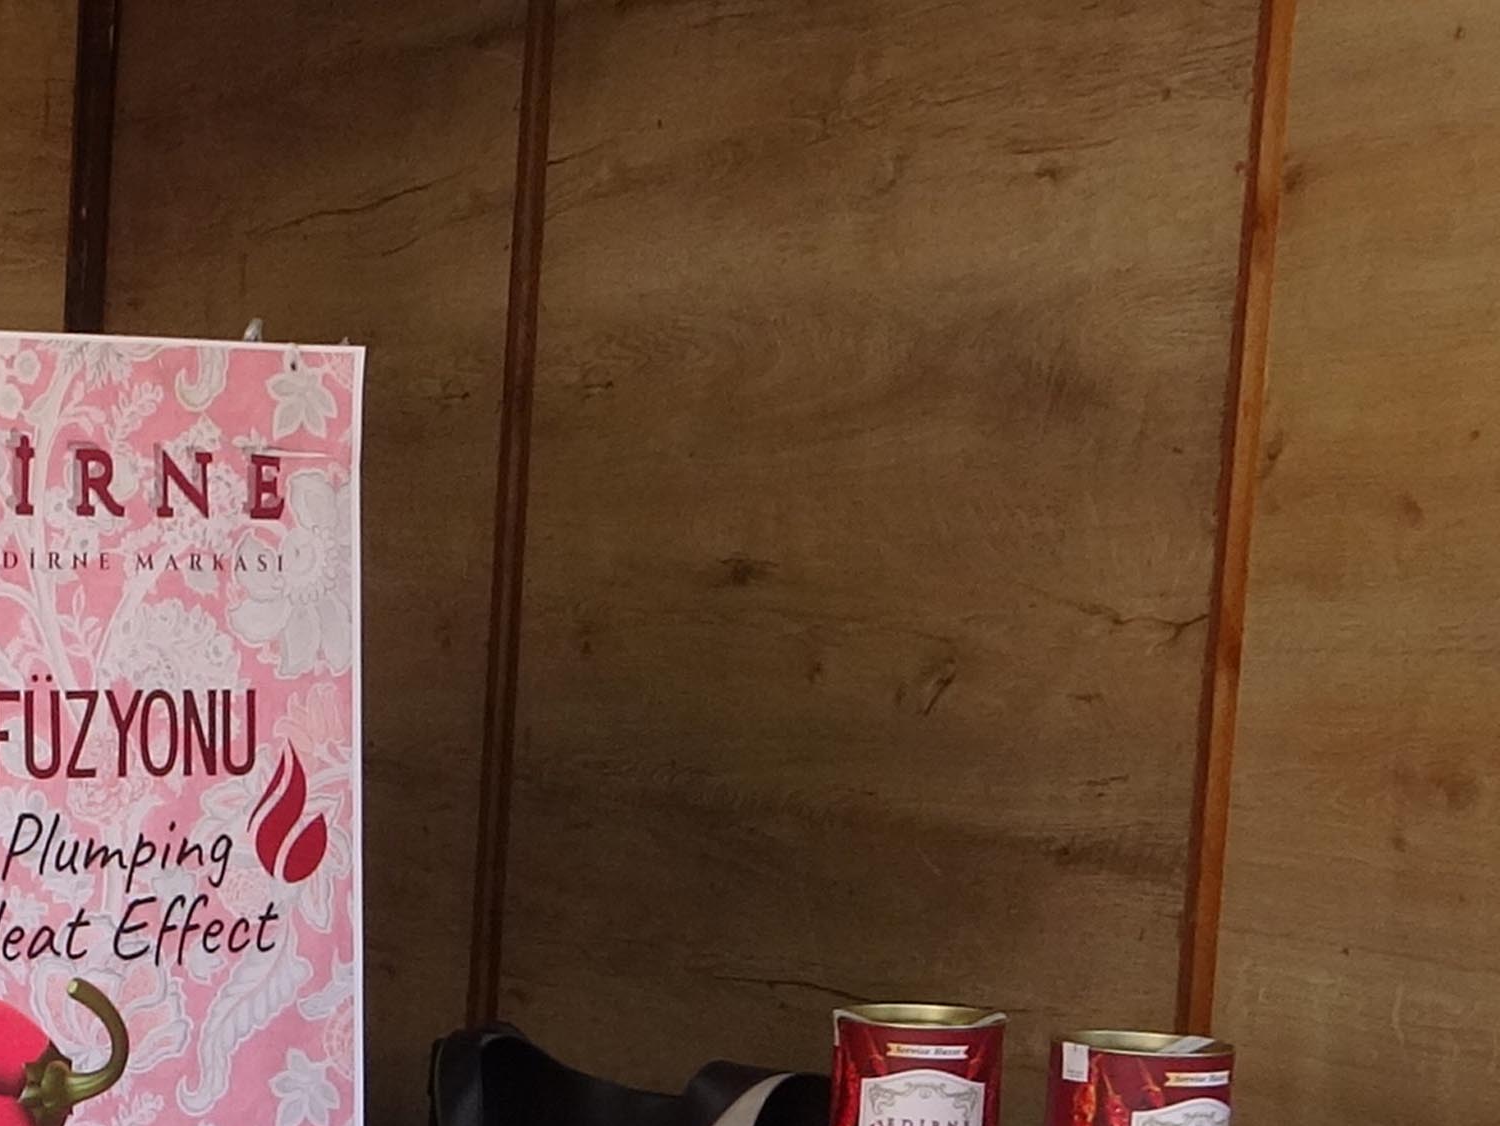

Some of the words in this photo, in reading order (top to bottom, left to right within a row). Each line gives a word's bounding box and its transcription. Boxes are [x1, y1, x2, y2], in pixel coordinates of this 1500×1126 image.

[134, 553, 285, 573] MARKASI
[0, 812, 233, 892] Plumping
[112, 893, 280, 967] Effect
